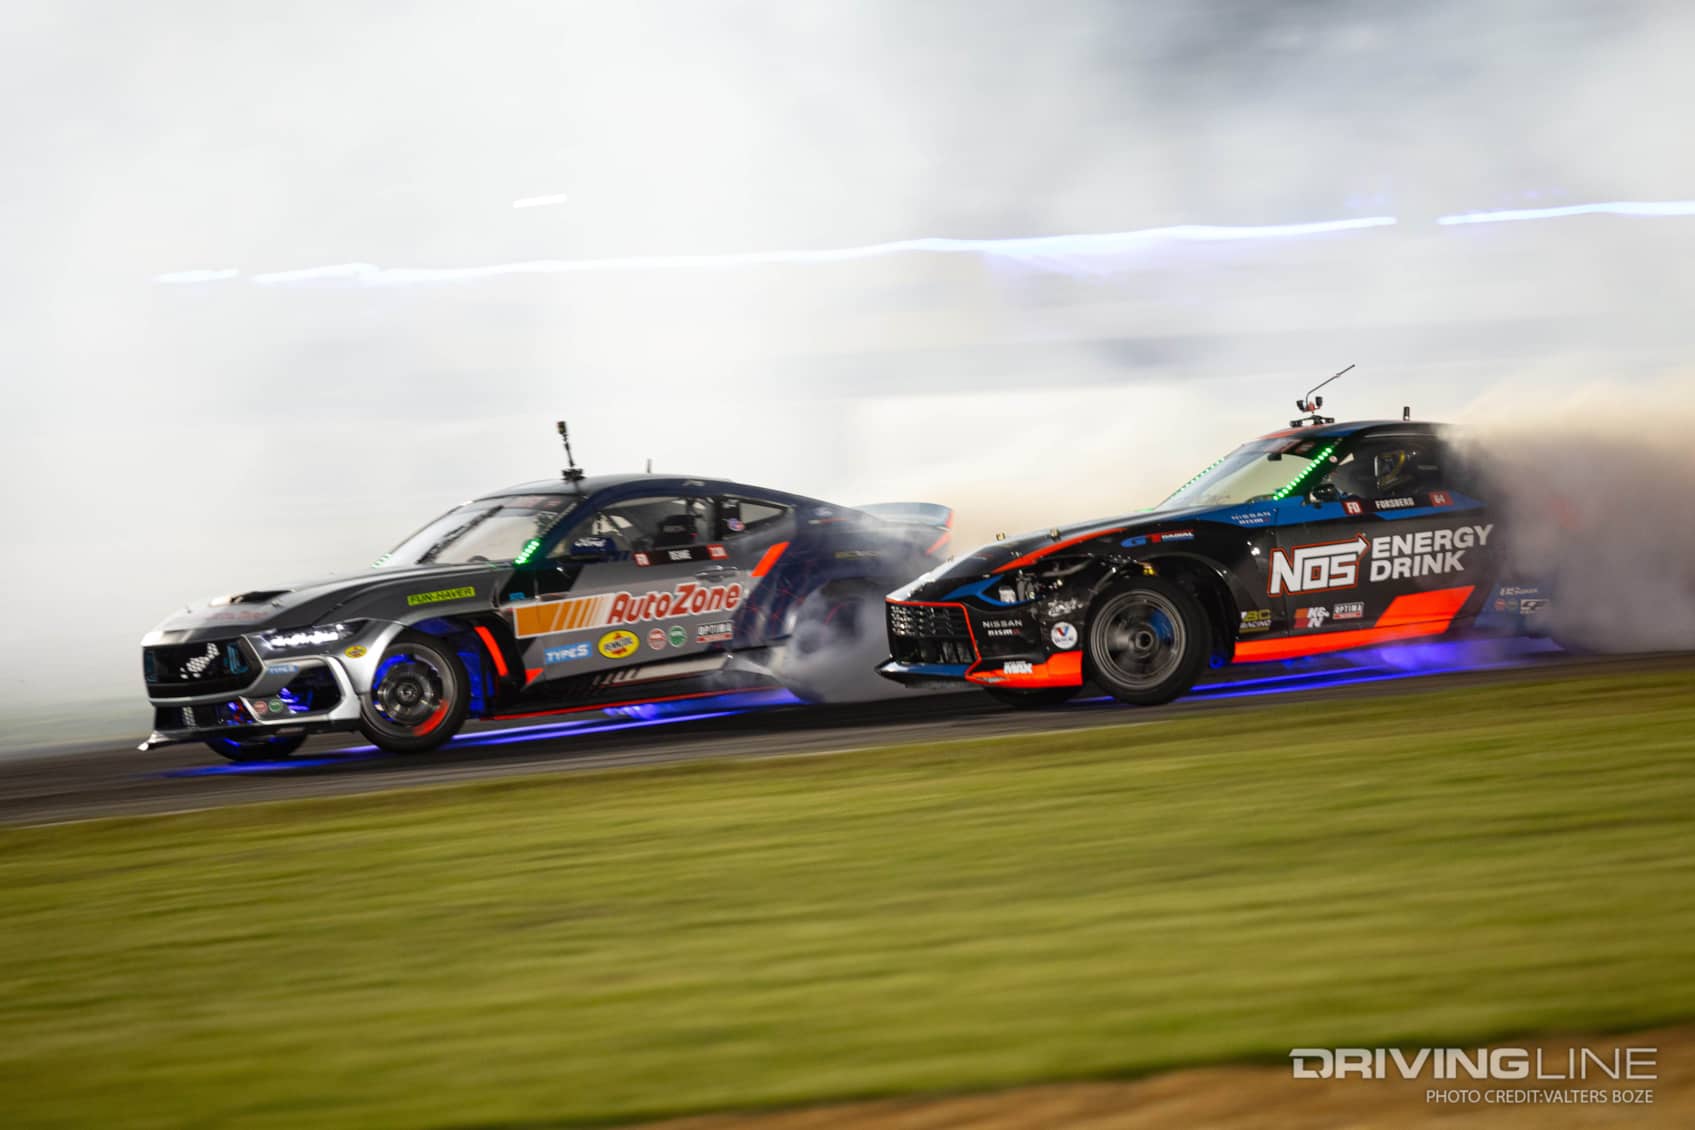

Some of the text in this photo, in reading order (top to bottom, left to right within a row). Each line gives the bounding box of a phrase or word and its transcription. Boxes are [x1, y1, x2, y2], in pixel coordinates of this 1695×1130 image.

[1371, 524, 1493, 559] ENERGY
[1267, 533, 1370, 597] NOS
[1369, 551, 1464, 583] DRINK
[606, 583, 742, 625] AutoZone
[982, 620, 1022, 628] NISSAN
